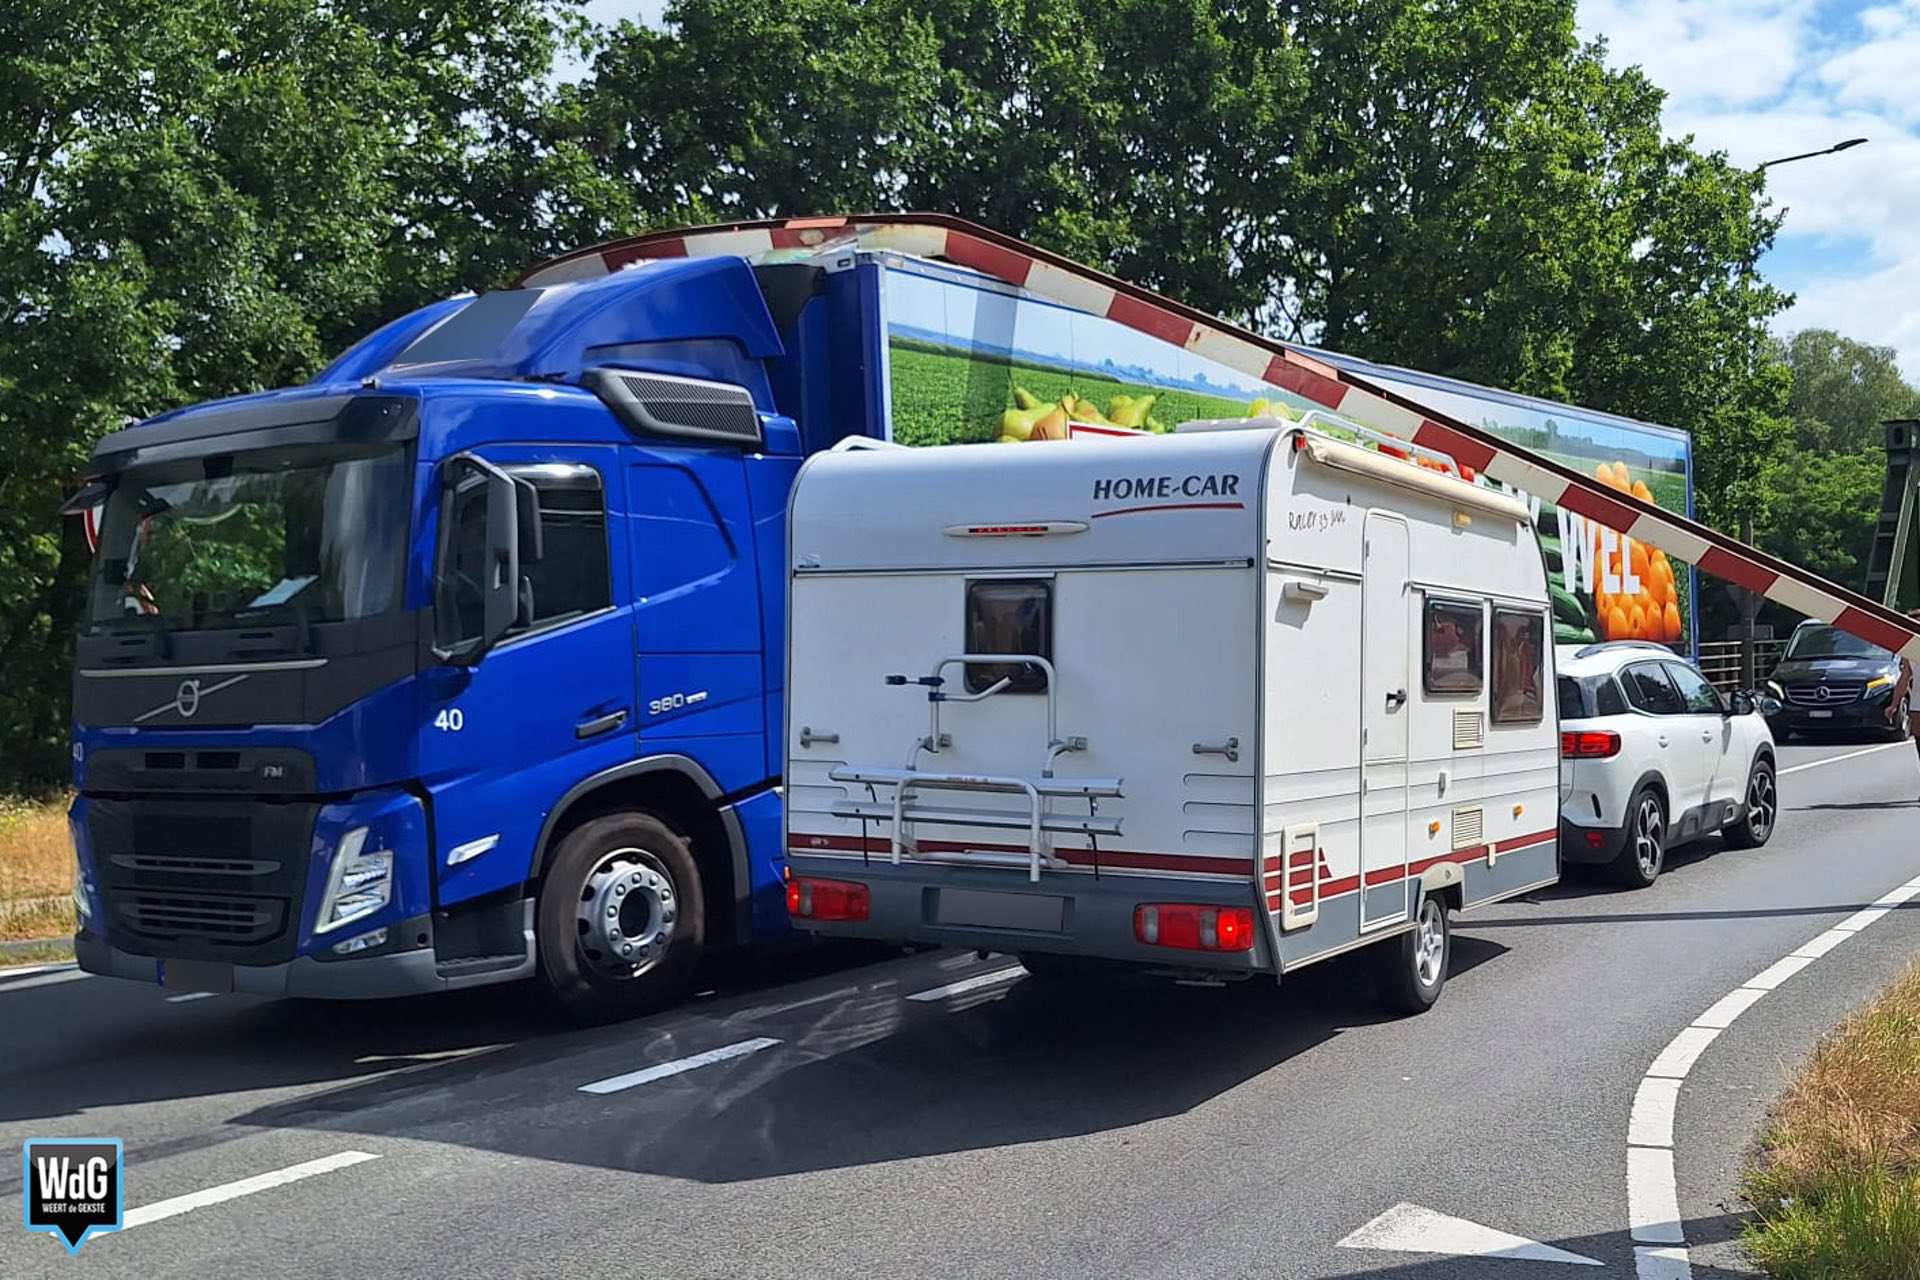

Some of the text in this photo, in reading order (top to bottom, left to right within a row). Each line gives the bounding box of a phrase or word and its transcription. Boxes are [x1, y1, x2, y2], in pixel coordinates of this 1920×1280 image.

[1092, 474, 1240, 500] HOME-CAR
[648, 693, 684, 715] 380
[434, 708, 464, 731] 40
[263, 765, 283, 778] FM
